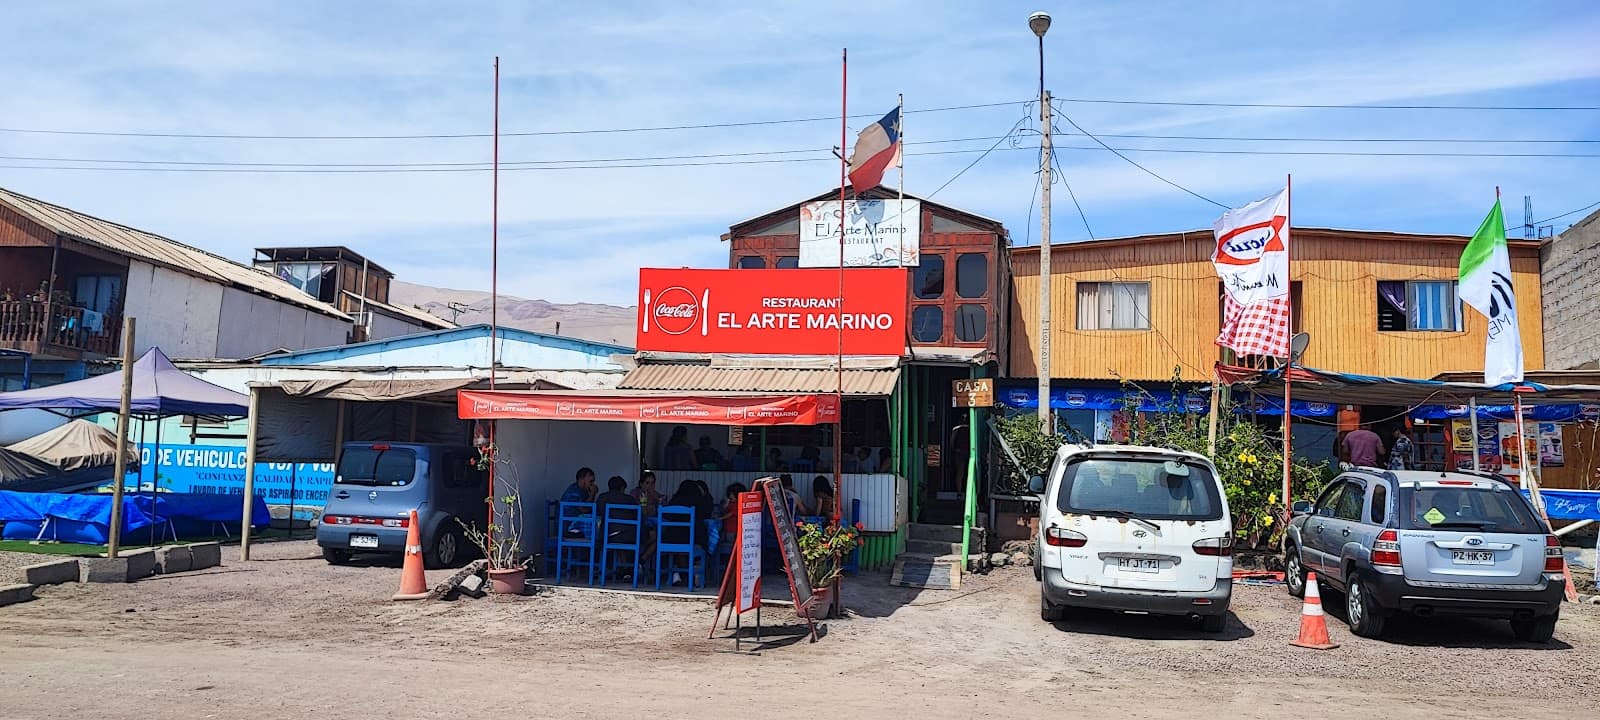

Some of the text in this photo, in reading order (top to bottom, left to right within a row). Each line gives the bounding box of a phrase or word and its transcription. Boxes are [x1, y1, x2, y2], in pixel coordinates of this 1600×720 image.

[815, 222, 907, 237] El Arte Marino
[762, 297, 843, 309] RESTAURANT
[717, 312, 893, 331] EL ARTE MARINO
[956, 381, 989, 393] CASA
[968, 392, 977, 407] 3
[177, 449, 247, 469] VEHICULO
[298, 475, 305, 485] Y
[269, 487, 304, 500] ASPIRDO
